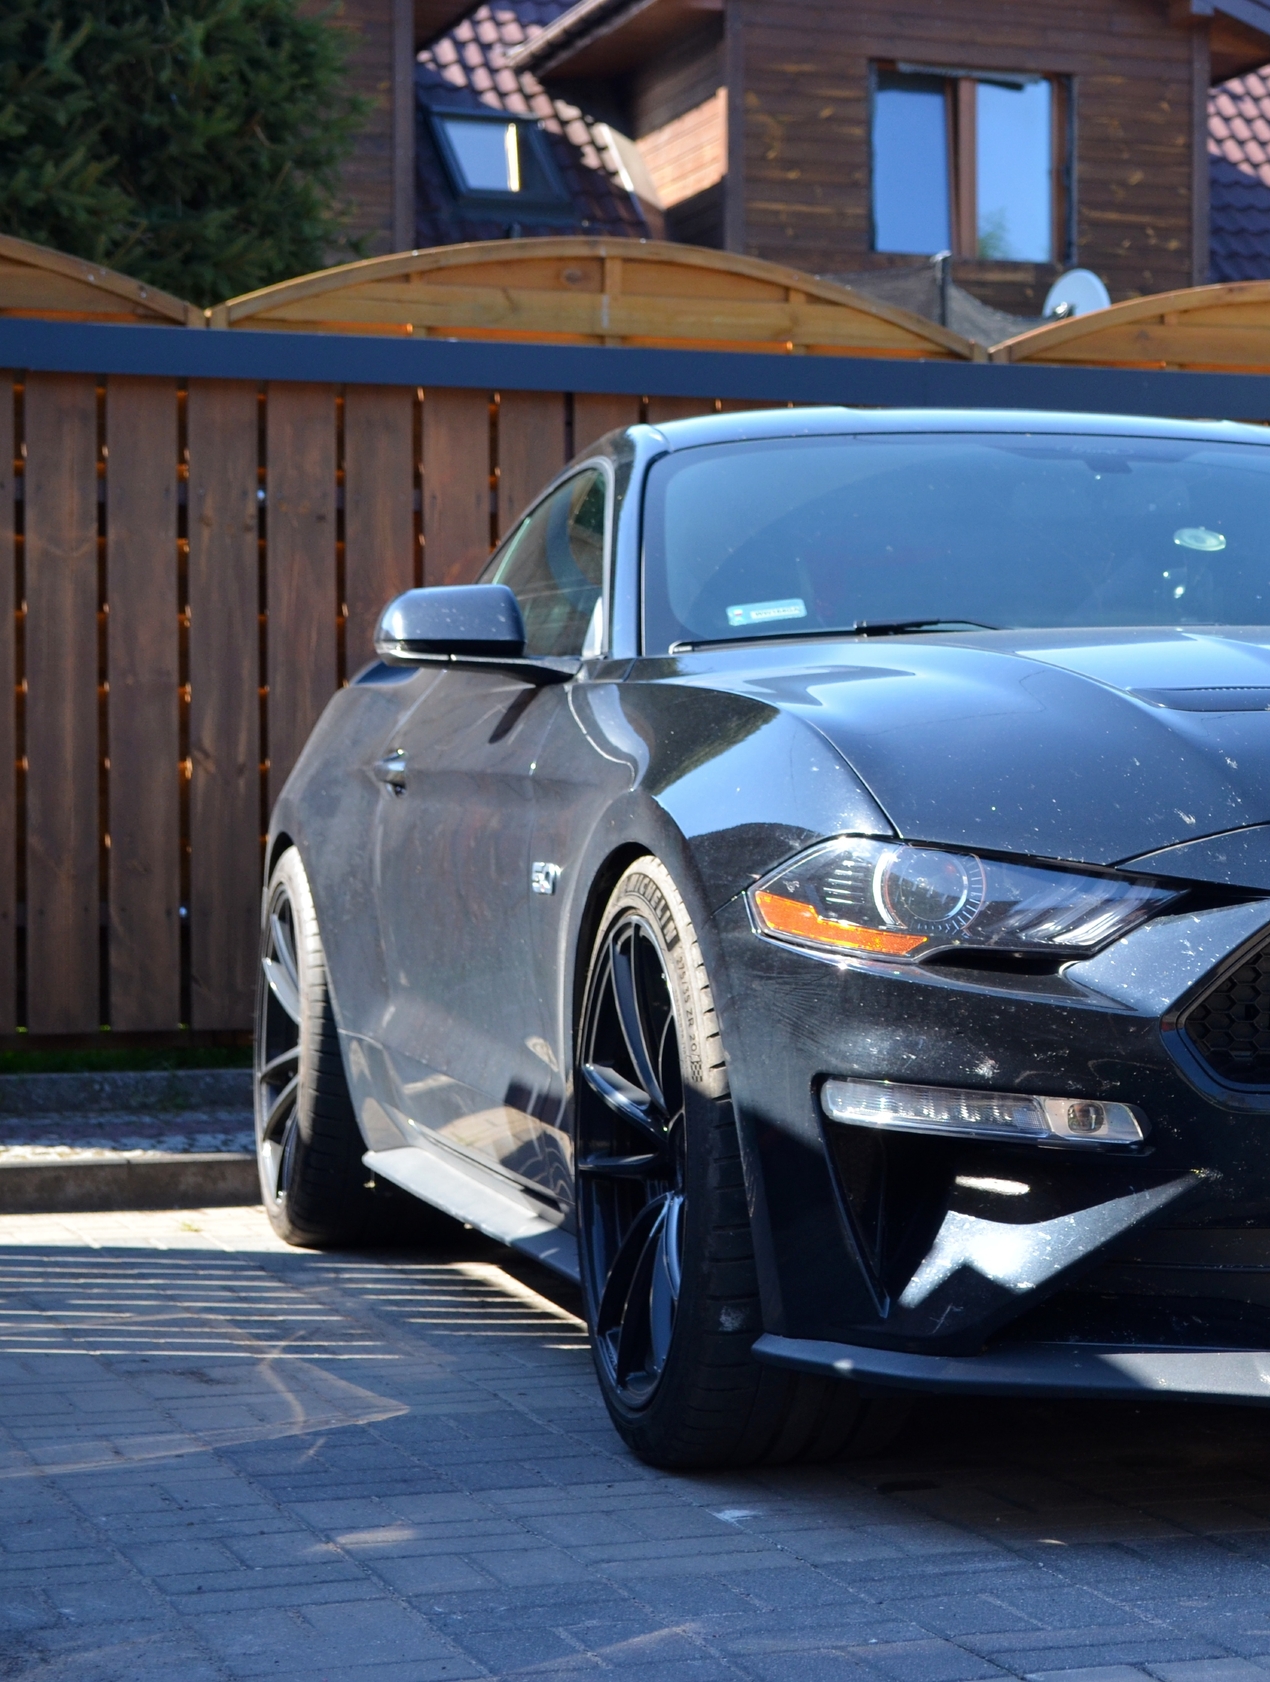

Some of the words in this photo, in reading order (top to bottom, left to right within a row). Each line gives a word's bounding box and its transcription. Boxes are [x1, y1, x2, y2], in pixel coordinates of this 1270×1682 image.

[625, 873, 678, 944] MICHELIN
[686, 1008, 695, 1028] ZR
[689, 1034, 698, 1052] 20
